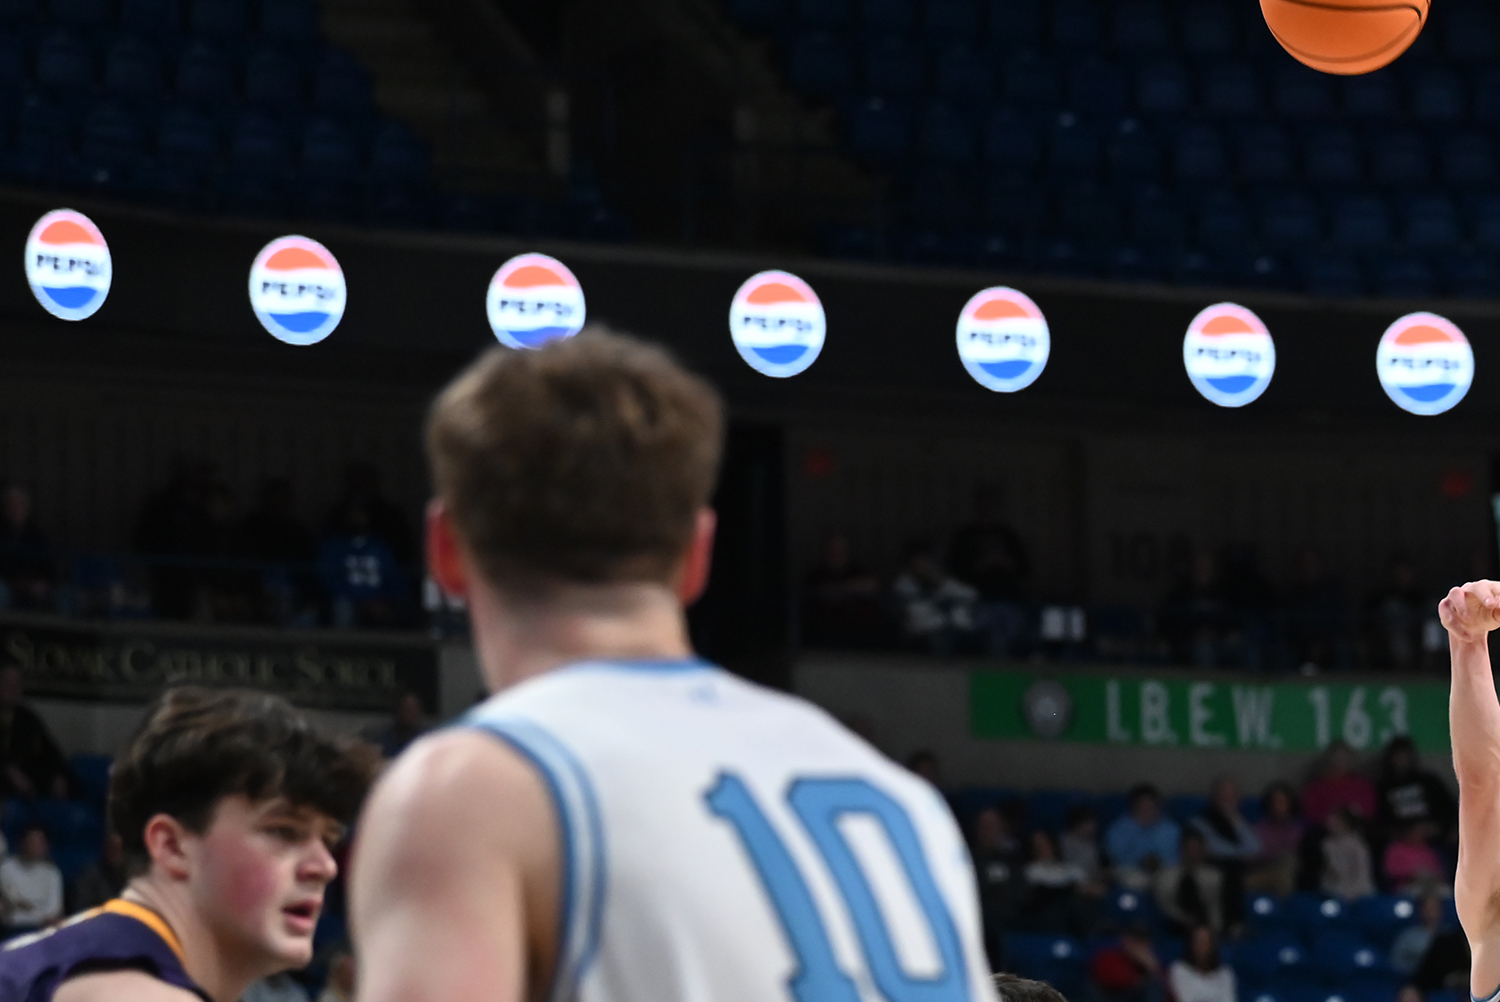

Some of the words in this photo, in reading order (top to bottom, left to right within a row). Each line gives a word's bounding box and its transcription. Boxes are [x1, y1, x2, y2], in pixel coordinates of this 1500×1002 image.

[37, 253, 105, 278] PEPSI
[261, 280, 336, 302] PEPSI
[121, 639, 292, 684] CATHOLIC
[1308, 685, 1410, 750] 163
